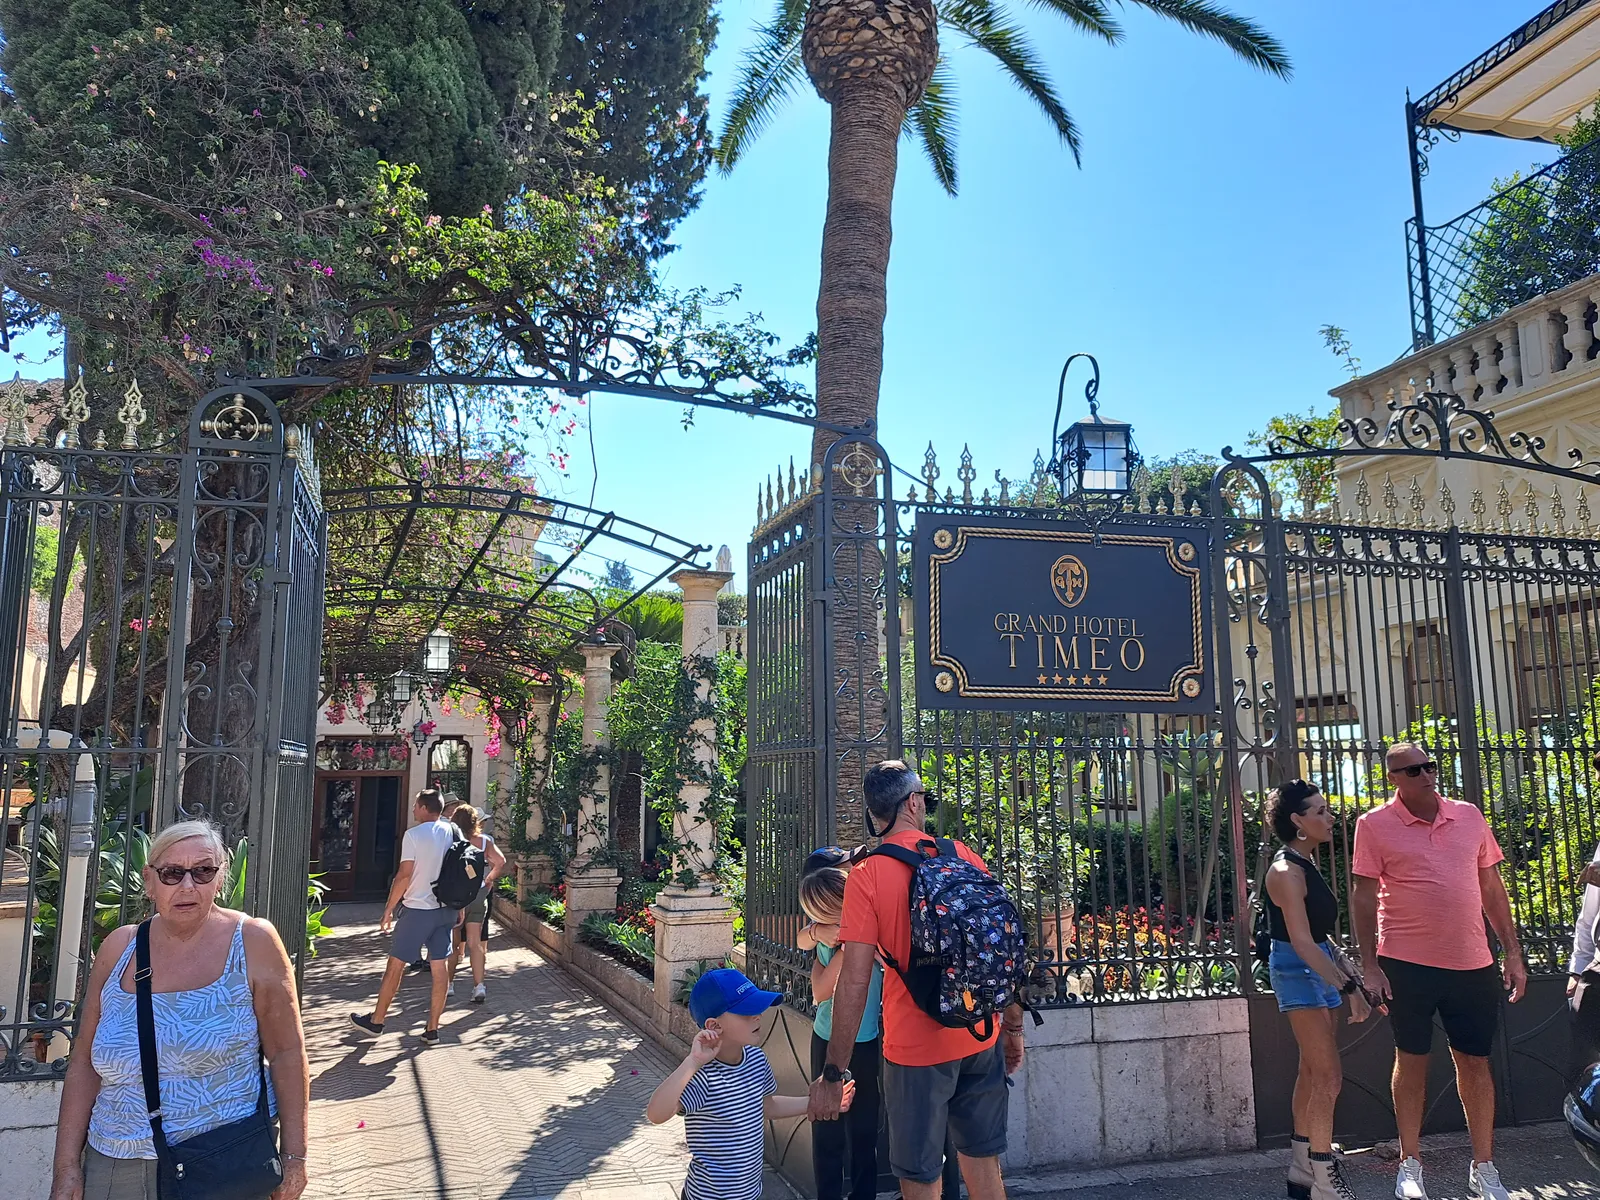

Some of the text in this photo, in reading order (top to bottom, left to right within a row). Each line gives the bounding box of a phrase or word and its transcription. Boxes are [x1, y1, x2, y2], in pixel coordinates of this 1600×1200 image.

[994, 612, 1145, 637] GRAND HOTEL
[999, 633, 1145, 671] TIMEO
